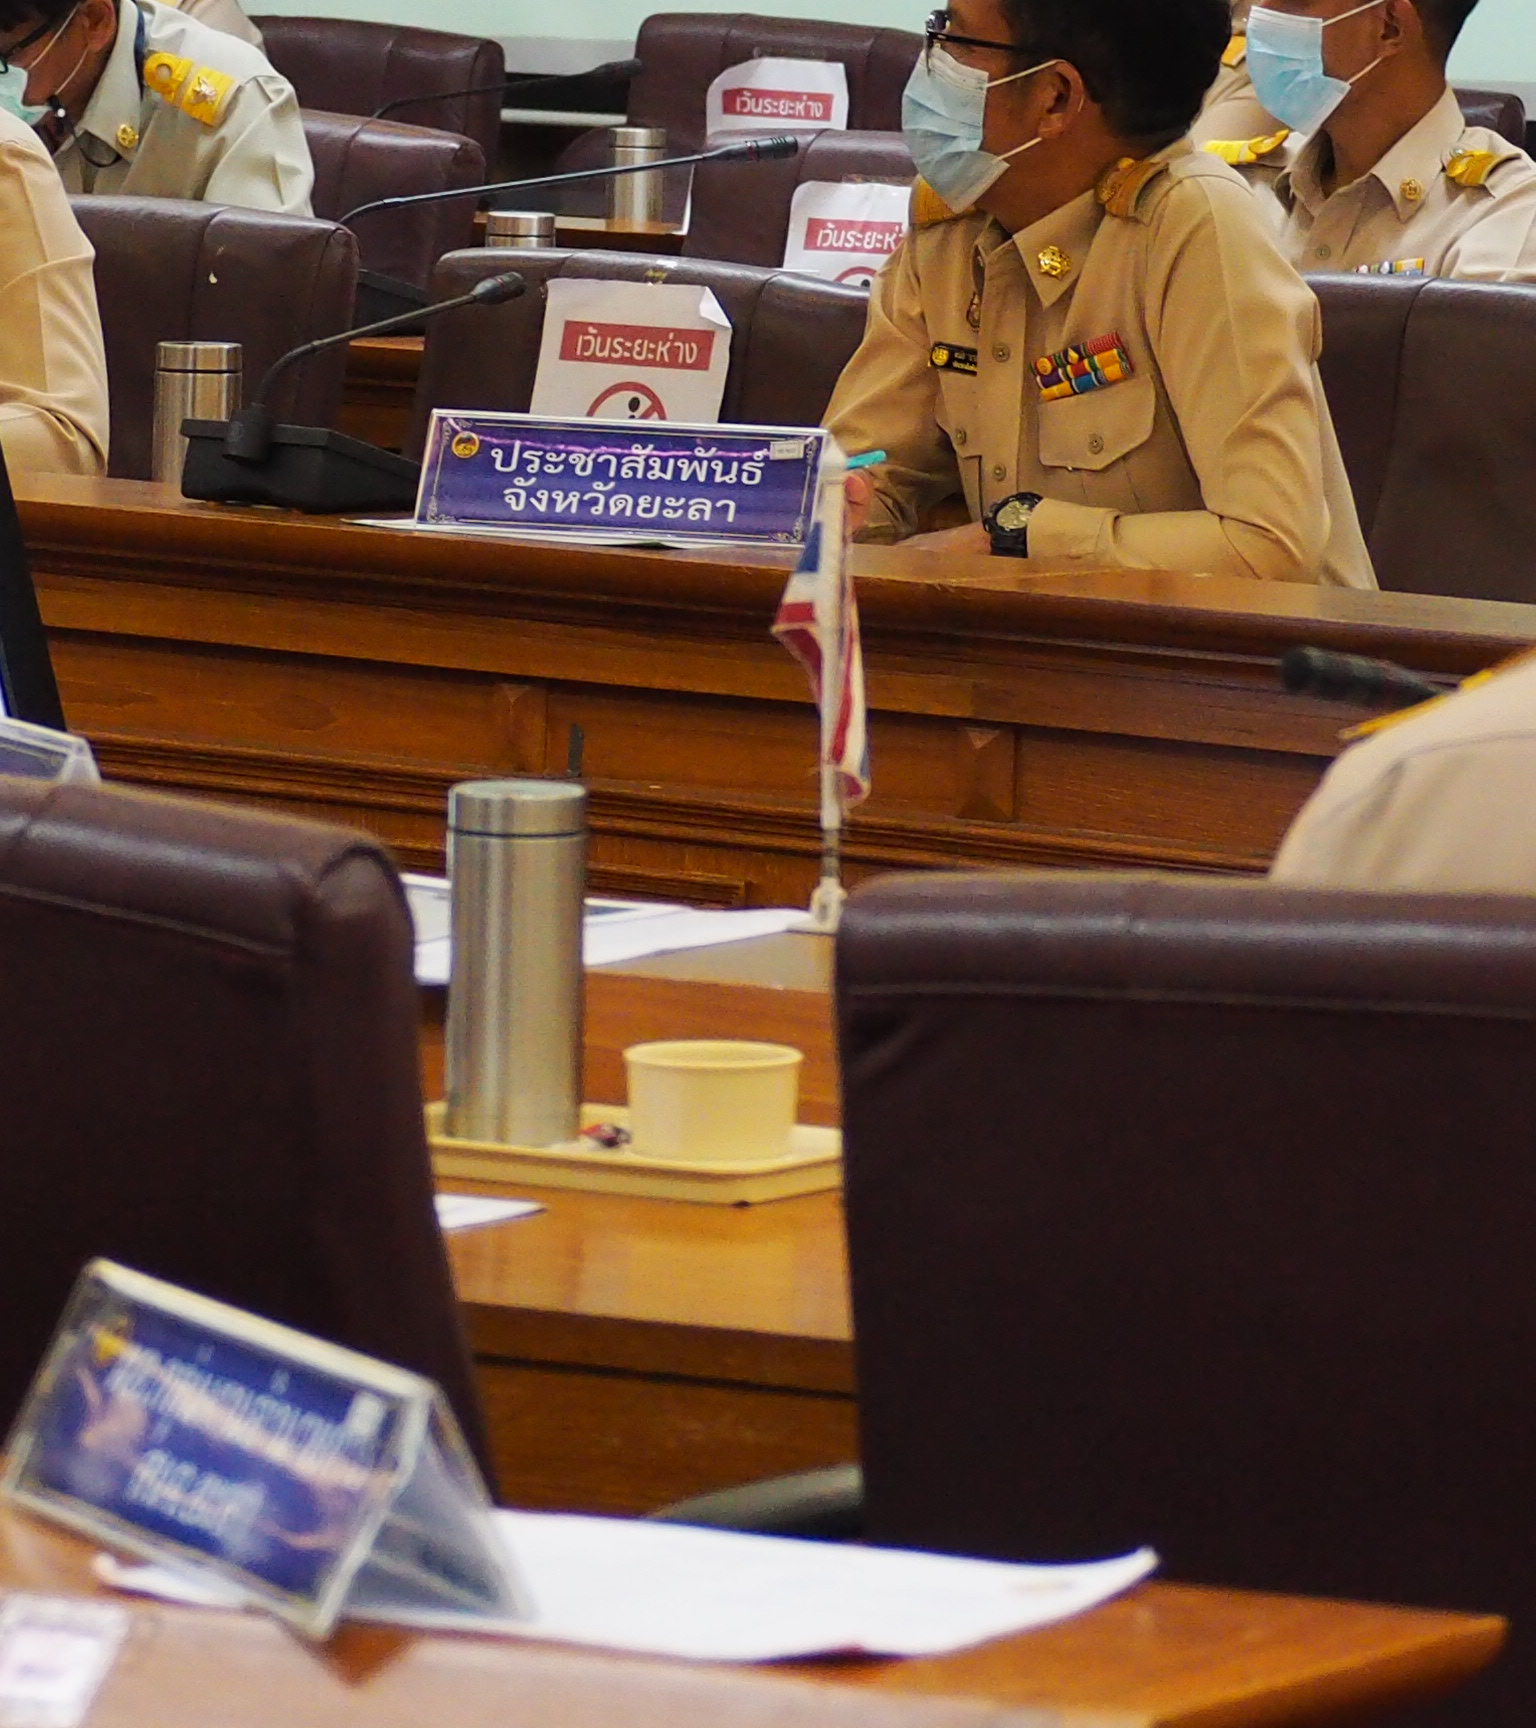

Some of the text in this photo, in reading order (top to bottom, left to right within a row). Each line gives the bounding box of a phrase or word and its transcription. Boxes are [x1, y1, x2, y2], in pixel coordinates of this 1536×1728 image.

[735, 90, 824, 118] เว้นระยะห่าง
[575, 325, 698, 365] เว้นระยะห่าง
[490, 440, 765, 486] ประชาสัมพันธ์
[502, 477, 737, 523] จังหวัดยะลา
